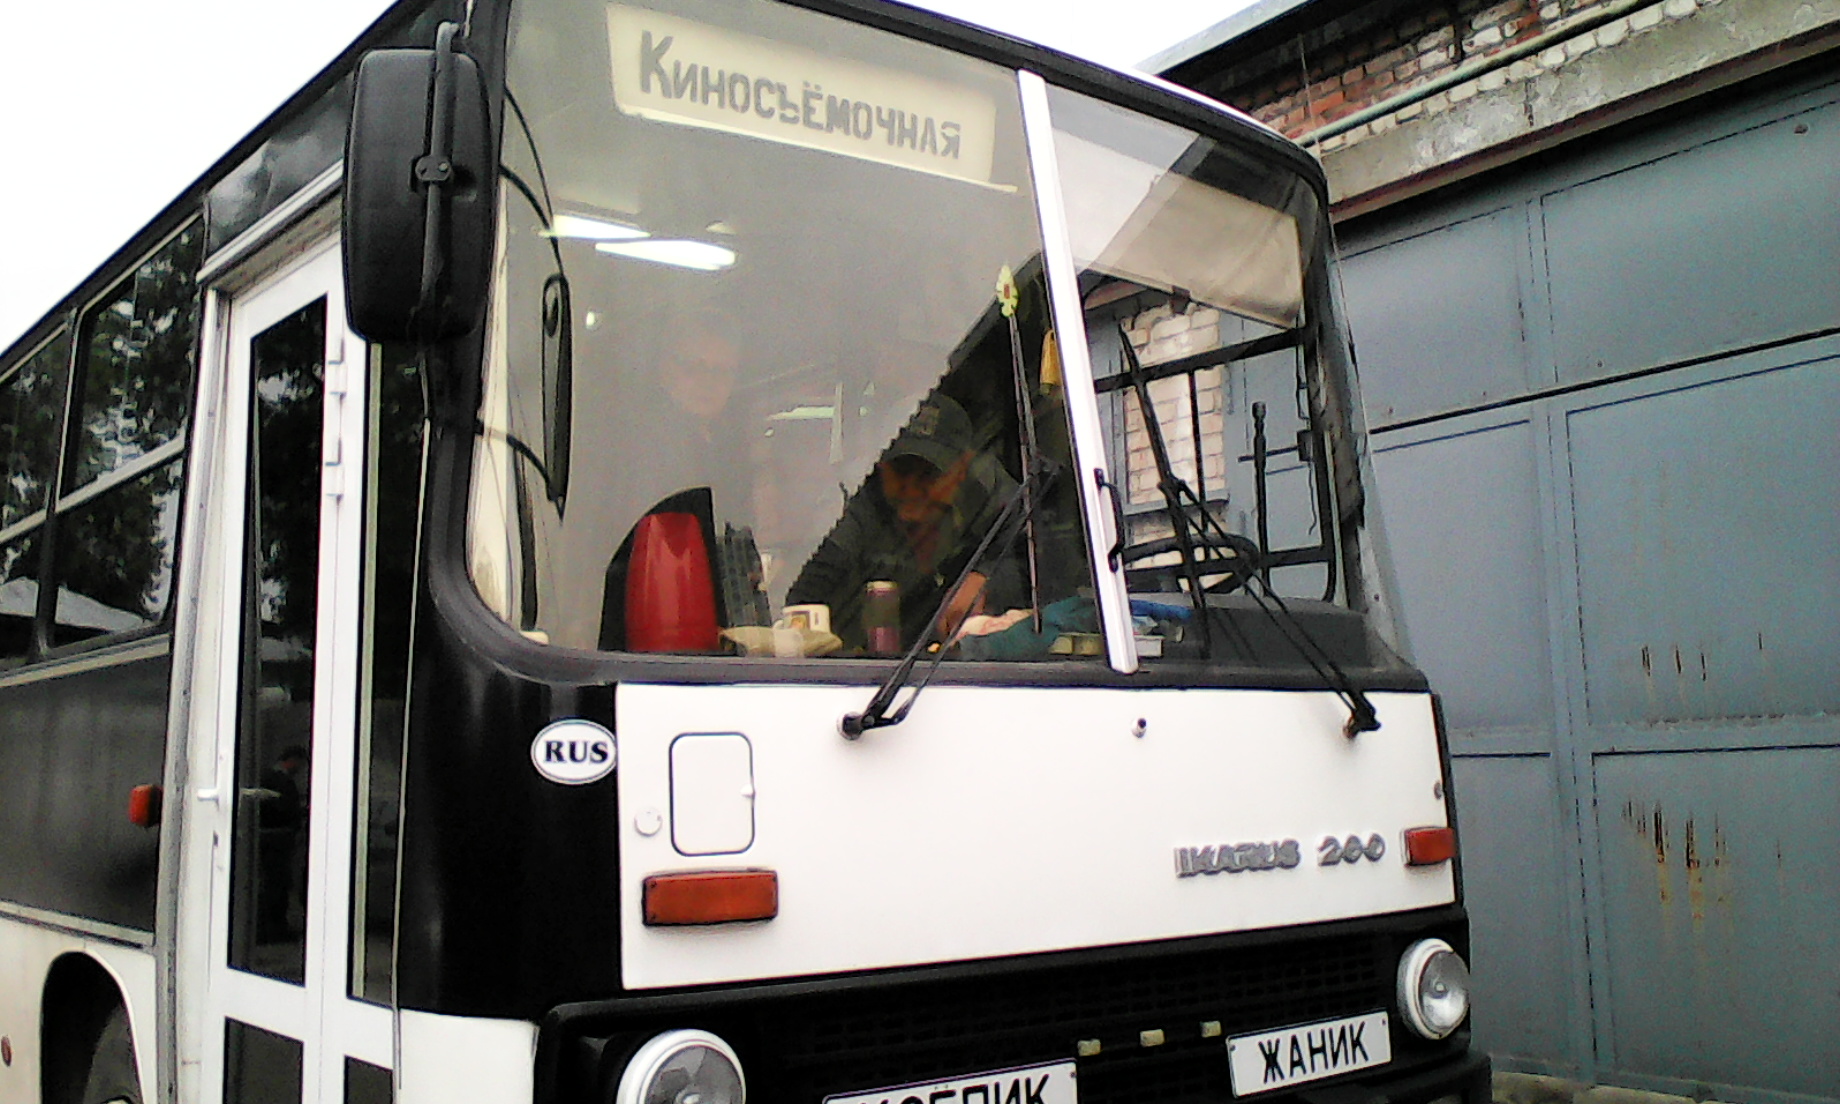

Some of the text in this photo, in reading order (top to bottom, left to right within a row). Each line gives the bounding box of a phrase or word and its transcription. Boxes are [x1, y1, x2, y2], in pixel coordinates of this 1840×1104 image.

[544, 740, 609, 764] RUS
[1174, 839, 1301, 878] IKARUS
[1257, 1021, 1369, 1084] ЖАНИК
